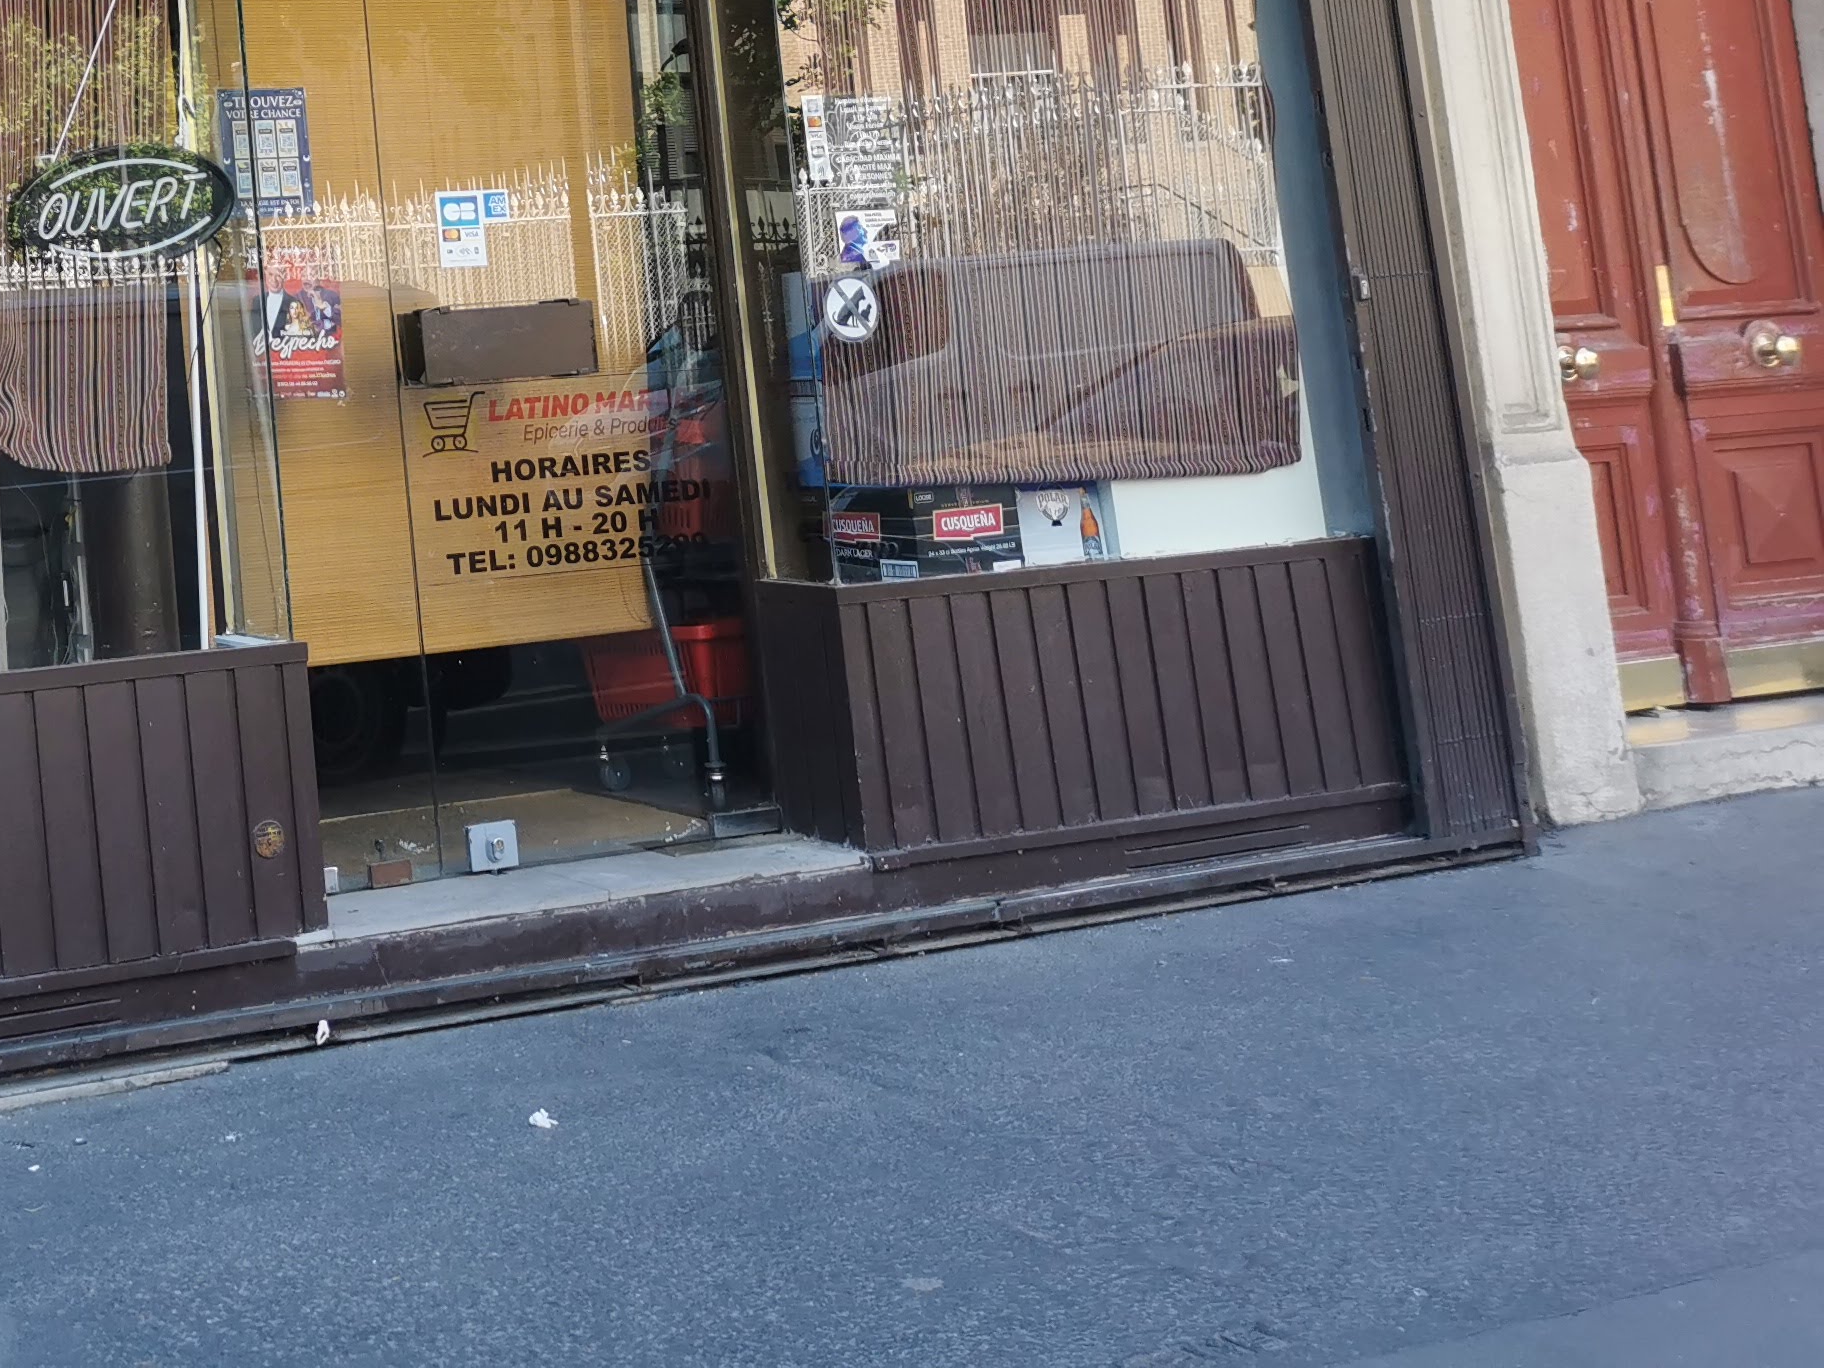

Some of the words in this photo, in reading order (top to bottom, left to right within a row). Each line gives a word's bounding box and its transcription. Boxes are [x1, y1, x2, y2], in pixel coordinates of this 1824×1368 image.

[261, 109, 301, 118] CHANCE
[38, 172, 208, 240] OUVERT
[488, 392, 589, 422] LATINO
[523, 421, 589, 445] Epicerie
[593, 418, 606, 436] &
[611, 414, 678, 435] Produits
[491, 450, 651, 482] HORAIRES
[433, 491, 530, 521] LUNDI
[542, 487, 583, 512] AU
[595, 479, 712, 507] SAMEDI
[1037, 492, 1068, 508] POLAR
[495, 518, 527, 544] 11
[541, 516, 563, 539] H
[592, 511, 627, 535] 20
[638, 507, 658, 531] H
[941, 510, 996, 532] CUSQUEÑA
[446, 549, 516, 575] TEL:
